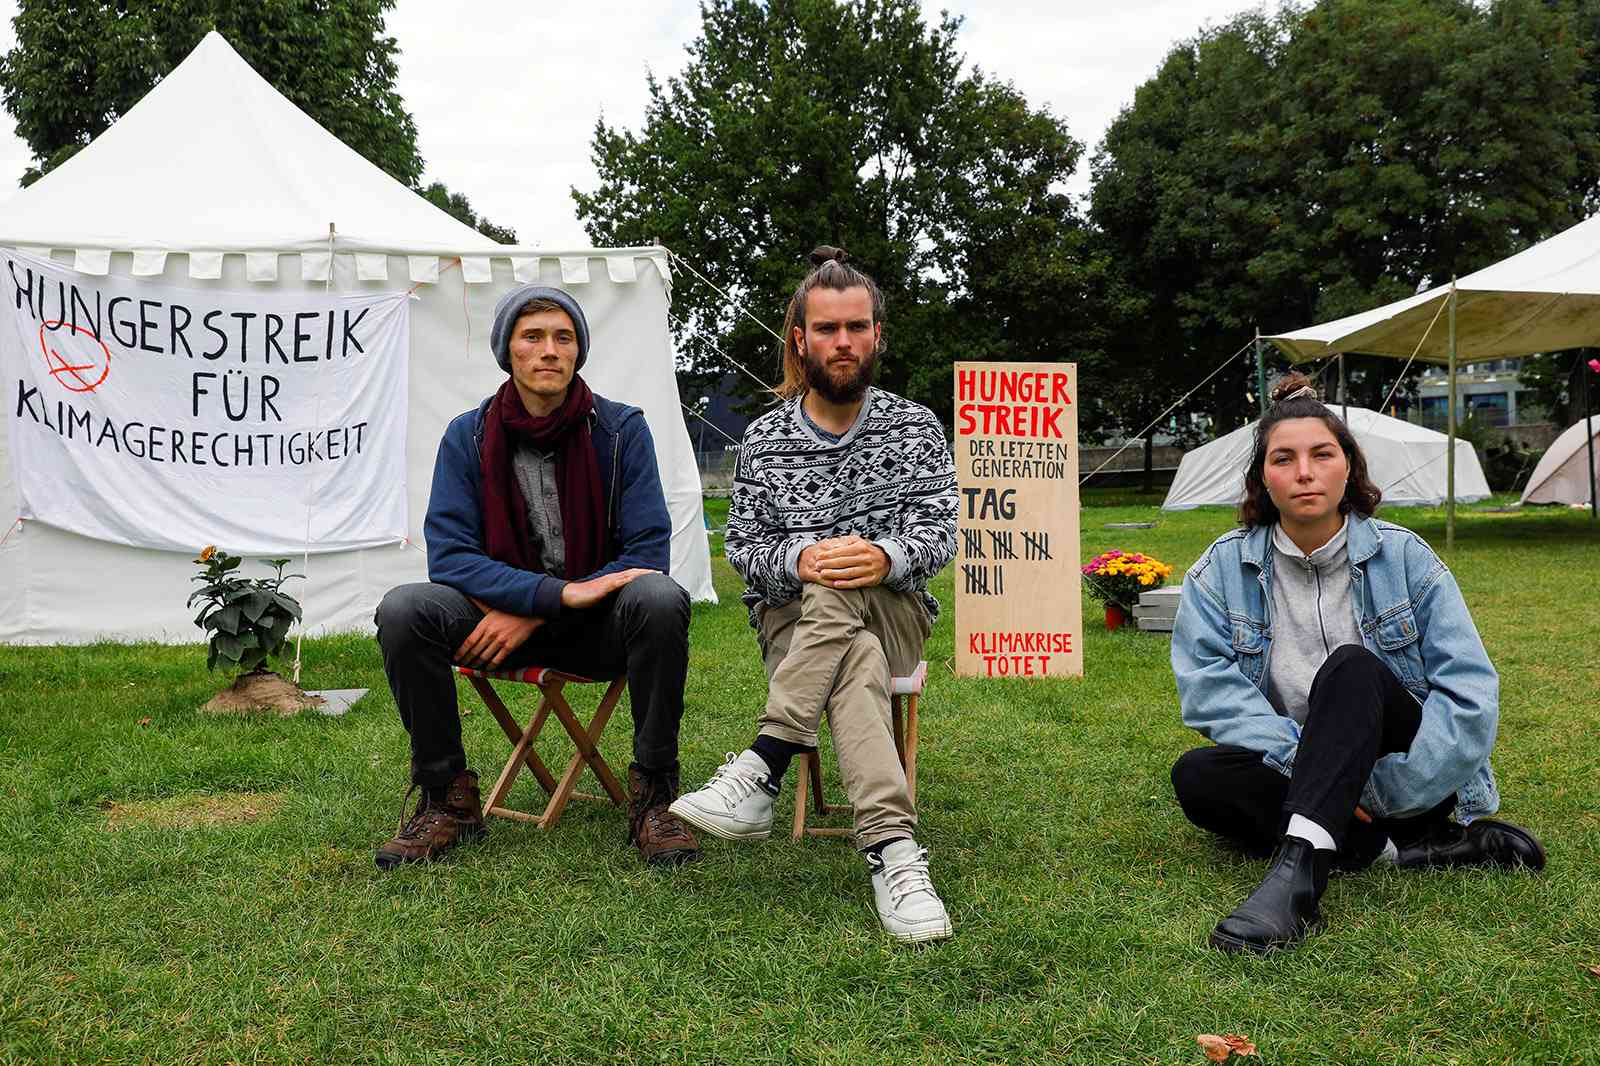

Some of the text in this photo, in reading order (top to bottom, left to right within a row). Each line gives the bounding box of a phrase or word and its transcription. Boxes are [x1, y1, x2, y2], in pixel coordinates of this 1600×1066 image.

[8, 260, 370, 365] HUNGERSTREIK
[193, 369, 282, 422] FÜR
[958, 370, 1072, 405] HUNGER
[16, 379, 368, 467] KLIMAGERECHTIGKEIT
[959, 404, 1063, 439] STREIK
[969, 440, 1068, 461] DER LETZTEN
[971, 458, 1065, 480] GENERATION
[962, 487, 1017, 521] TAG
[969, 632, 1073, 655] KLIMAKRISE
